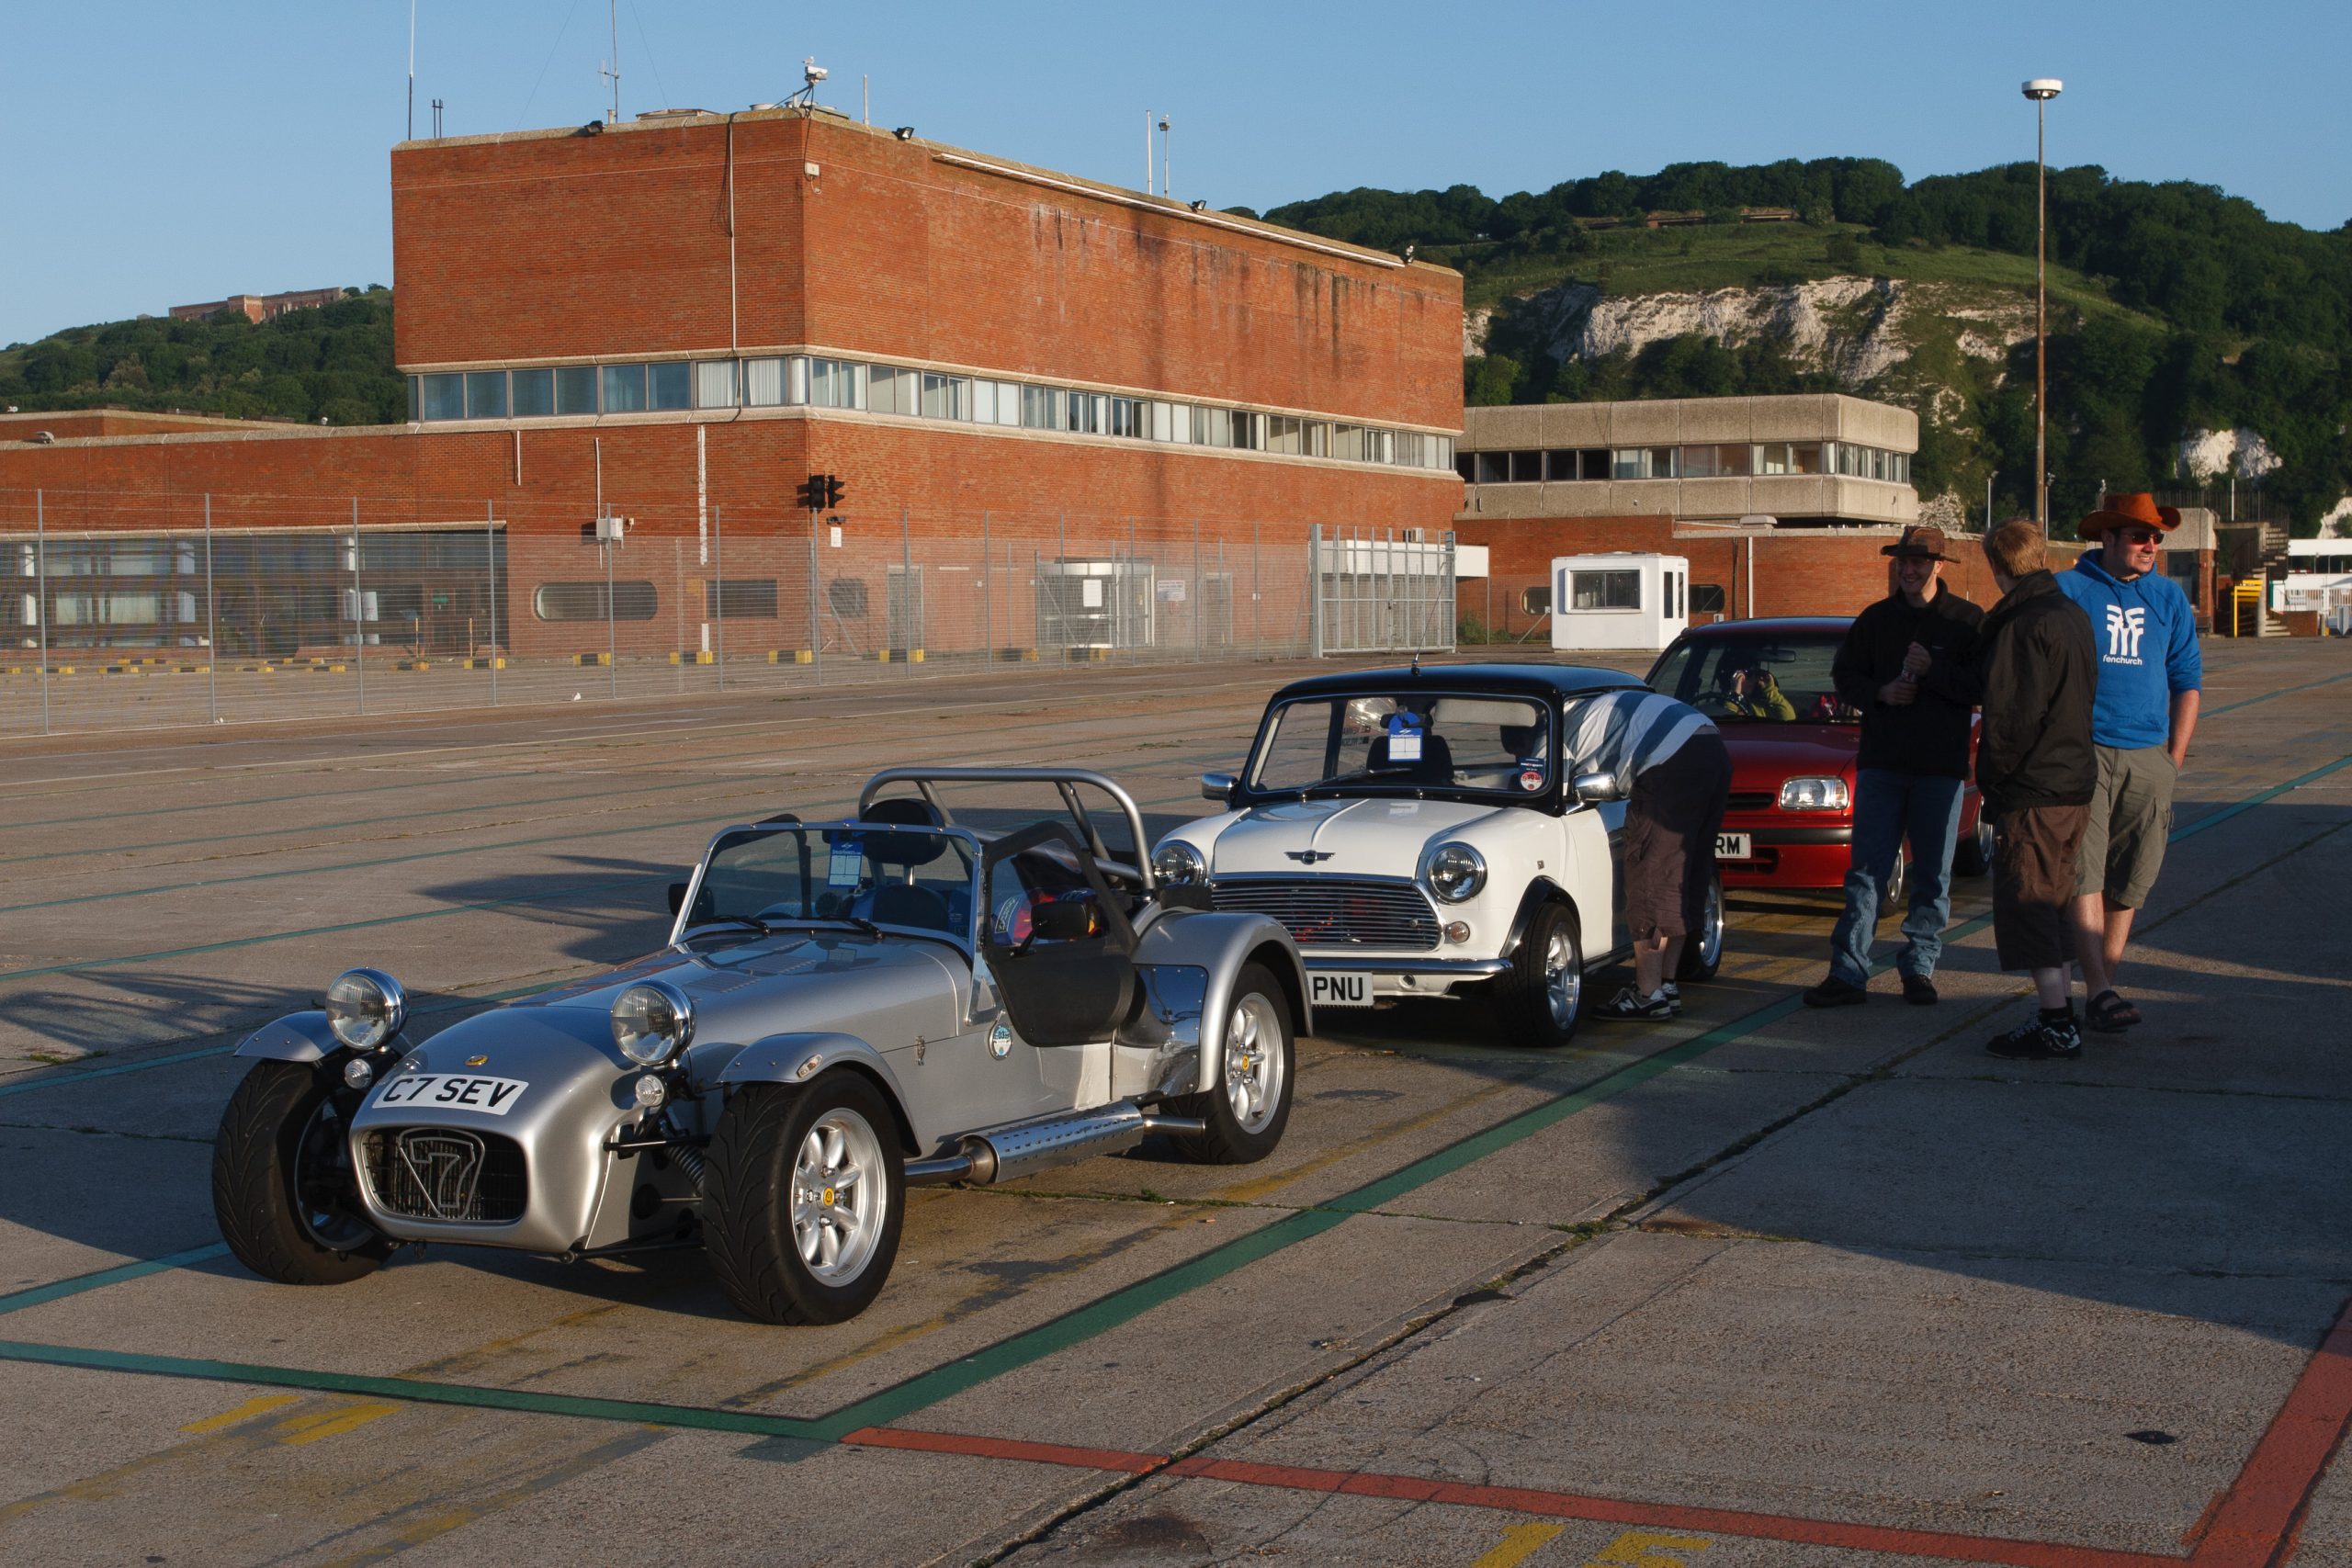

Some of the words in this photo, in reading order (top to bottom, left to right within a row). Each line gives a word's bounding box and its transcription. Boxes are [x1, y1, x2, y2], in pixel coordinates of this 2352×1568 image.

[2103, 654, 2143, 665] fenchurch
[1714, 835, 1740, 855] RM
[1312, 976, 1363, 1001] PNU
[383, 1077, 438, 1102] C7
[435, 1078, 518, 1107] SEV
[410, 1137, 476, 1208] 7
